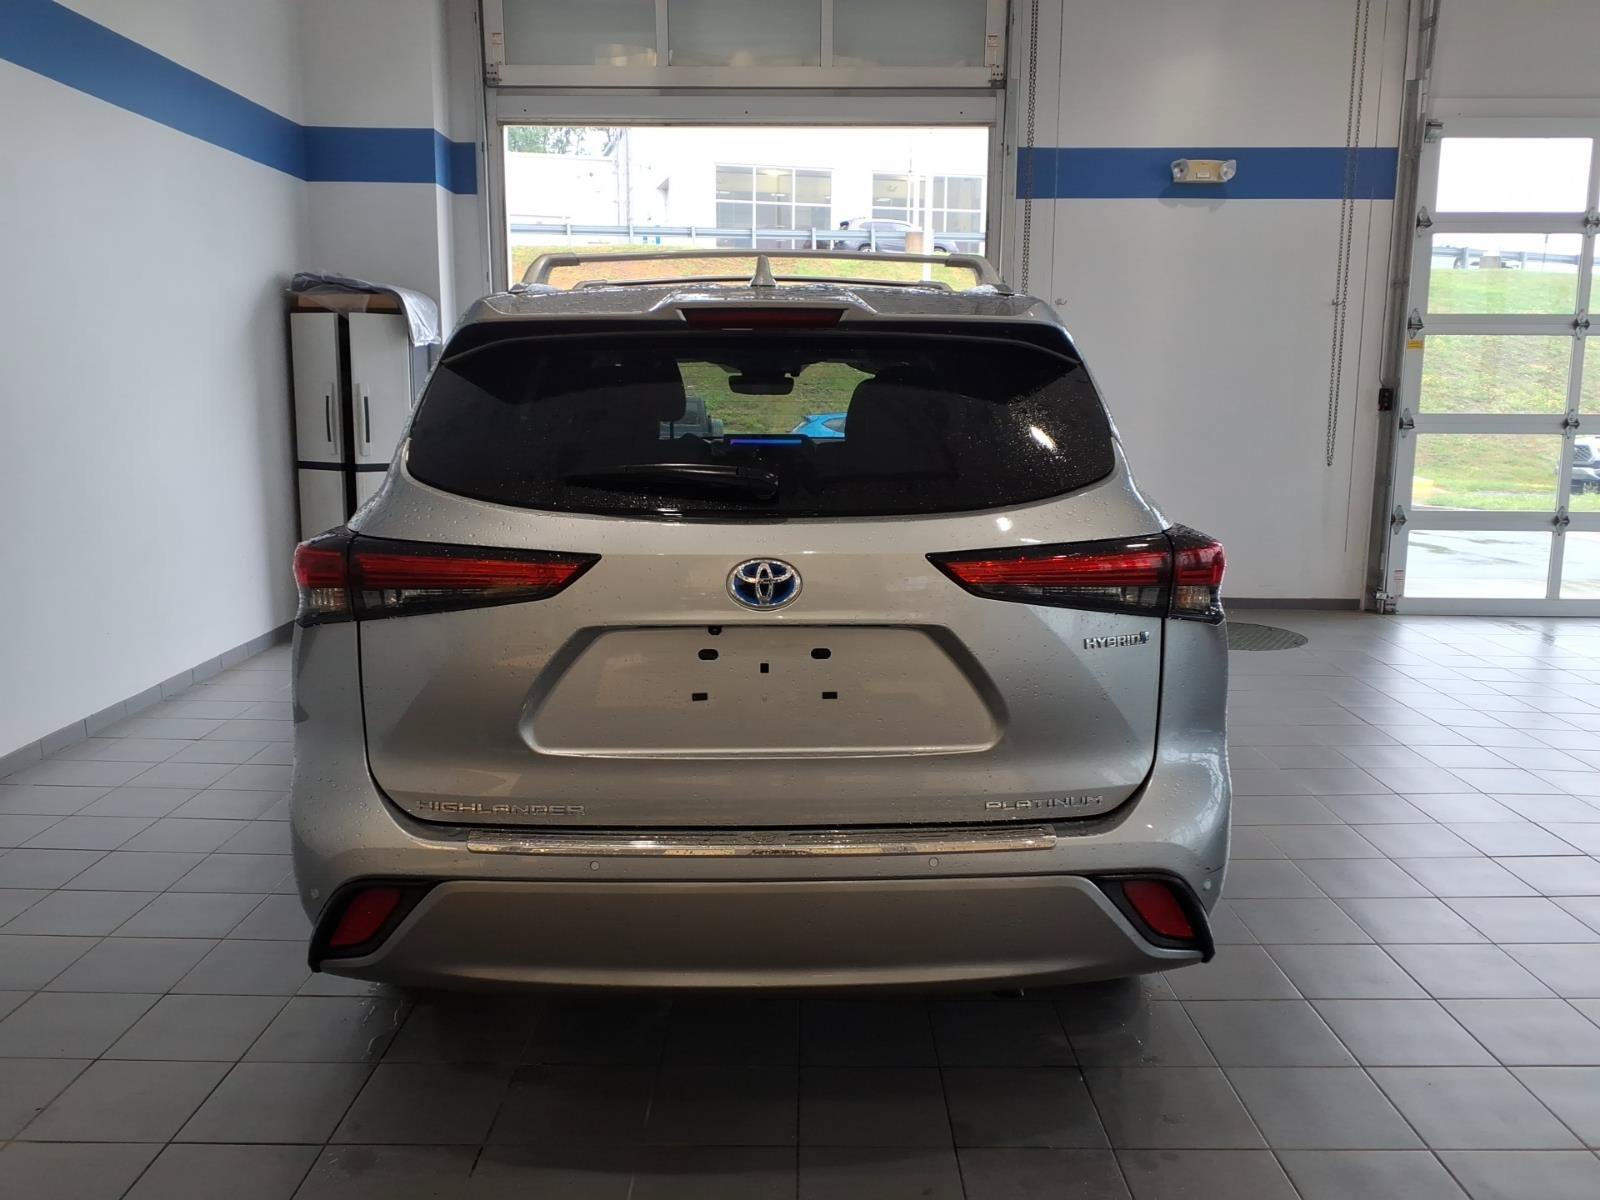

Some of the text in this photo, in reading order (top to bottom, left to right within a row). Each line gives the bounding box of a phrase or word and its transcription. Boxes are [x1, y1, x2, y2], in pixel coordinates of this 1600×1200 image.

[1083, 634, 1140, 649] HYBRID
[416, 800, 586, 816] HIGHLANDER
[985, 795, 1103, 810] PLATINUM
